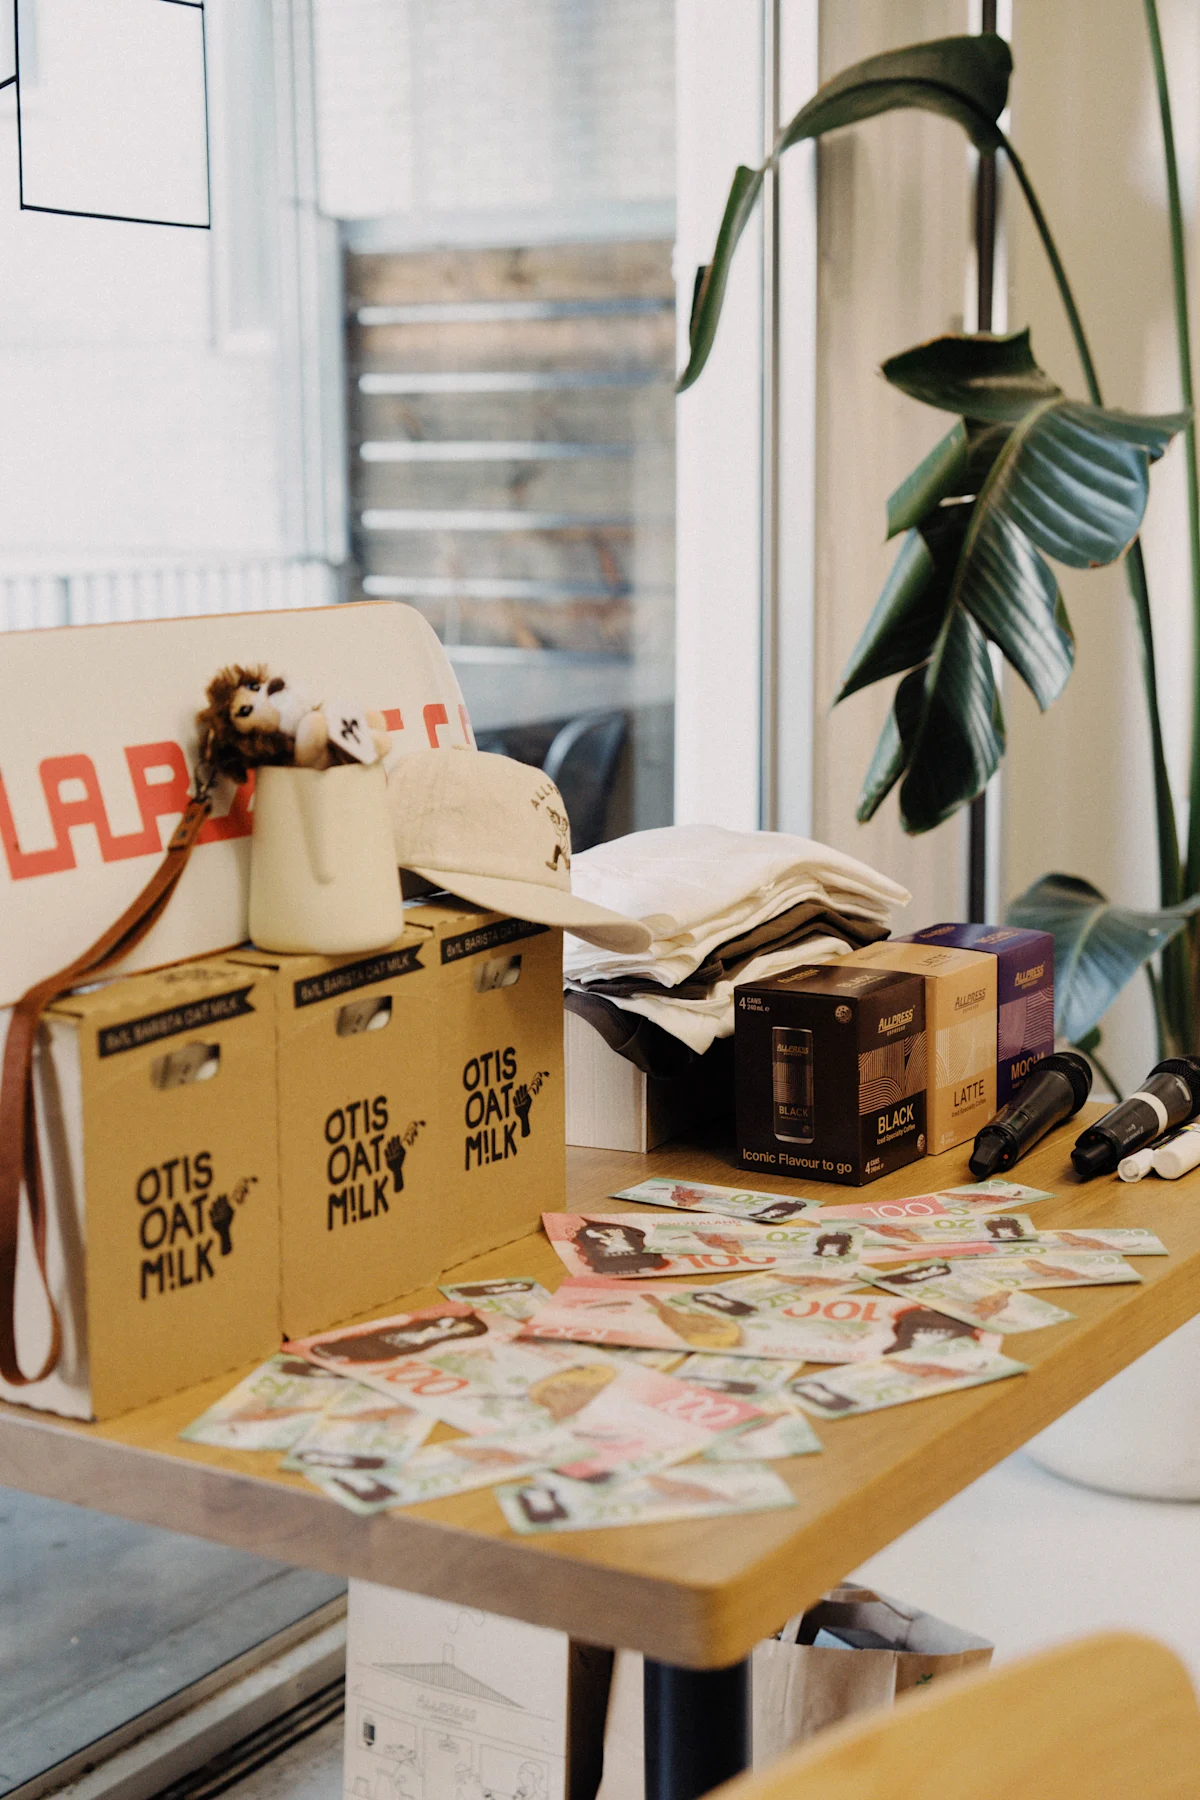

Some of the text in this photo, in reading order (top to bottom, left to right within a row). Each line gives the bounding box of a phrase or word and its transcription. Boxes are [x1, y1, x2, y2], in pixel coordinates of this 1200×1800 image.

[464, 931, 498, 951] BARISTA
[323, 969, 364, 994] BARISTA
[387, 953, 410, 971] MILK
[1014, 963, 1046, 987] ALLPRESS
[739, 996, 762, 1010] 4 CANS
[954, 988, 987, 1012] ALLPRESS
[132, 1012, 184, 1041] BARISTA
[878, 1008, 915, 1034] ALLPRESS
[777, 1043, 809, 1055] ALLPRESS
[462, 1046, 518, 1093] OTIS
[953, 1079, 985, 1107] LATTE
[324, 1094, 390, 1147] OTIS
[464, 1086, 515, 1130] OAT
[779, 1105, 809, 1117] BLACK
[878, 1103, 914, 1134] BLACK
[876, 1136, 886, 1146] Iced
[903, 1123, 916, 1134] Coffee
[326, 1135, 388, 1187] OAT
[742, 1149, 853, 1174] Iconic Flavour to go
[864, 1161, 871, 1175] 4
[135, 1150, 214, 1207] OTIS
[139, 1192, 208, 1251] OAT
[862, 1202, 934, 1218] 100
